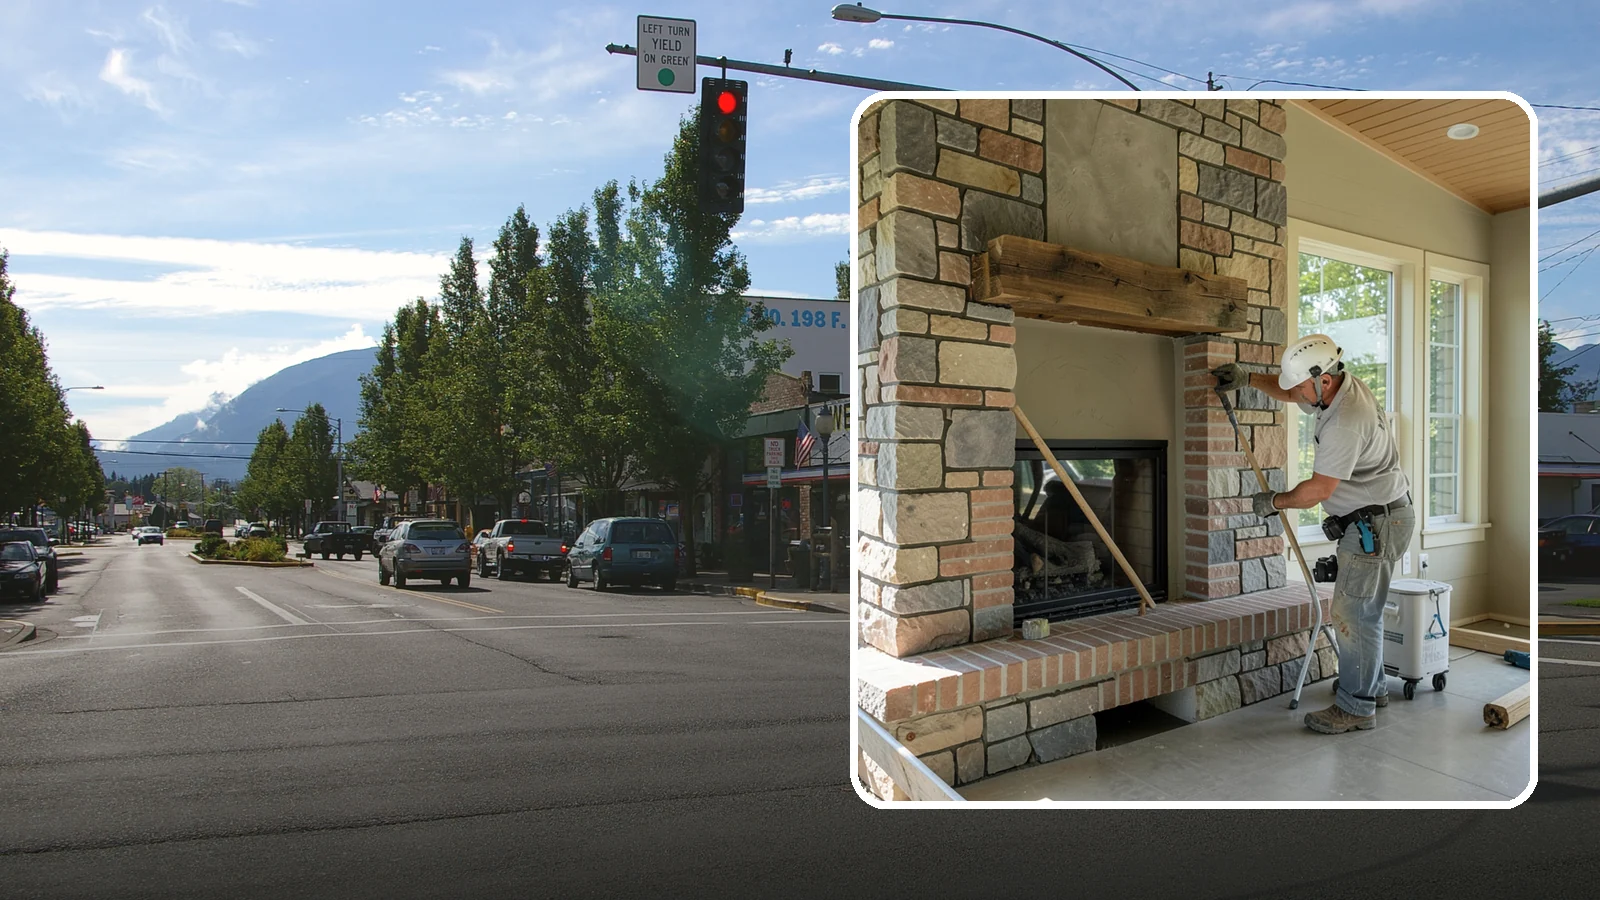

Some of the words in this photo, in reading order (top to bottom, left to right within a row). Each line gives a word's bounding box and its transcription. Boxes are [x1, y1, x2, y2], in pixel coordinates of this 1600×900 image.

[643, 24, 663, 34] LEFT
[668, 26, 690, 36] TURN
[652, 38, 682, 52] YIELD
[791, 309, 826, 328] 198
[831, 311, 846, 328] F.
